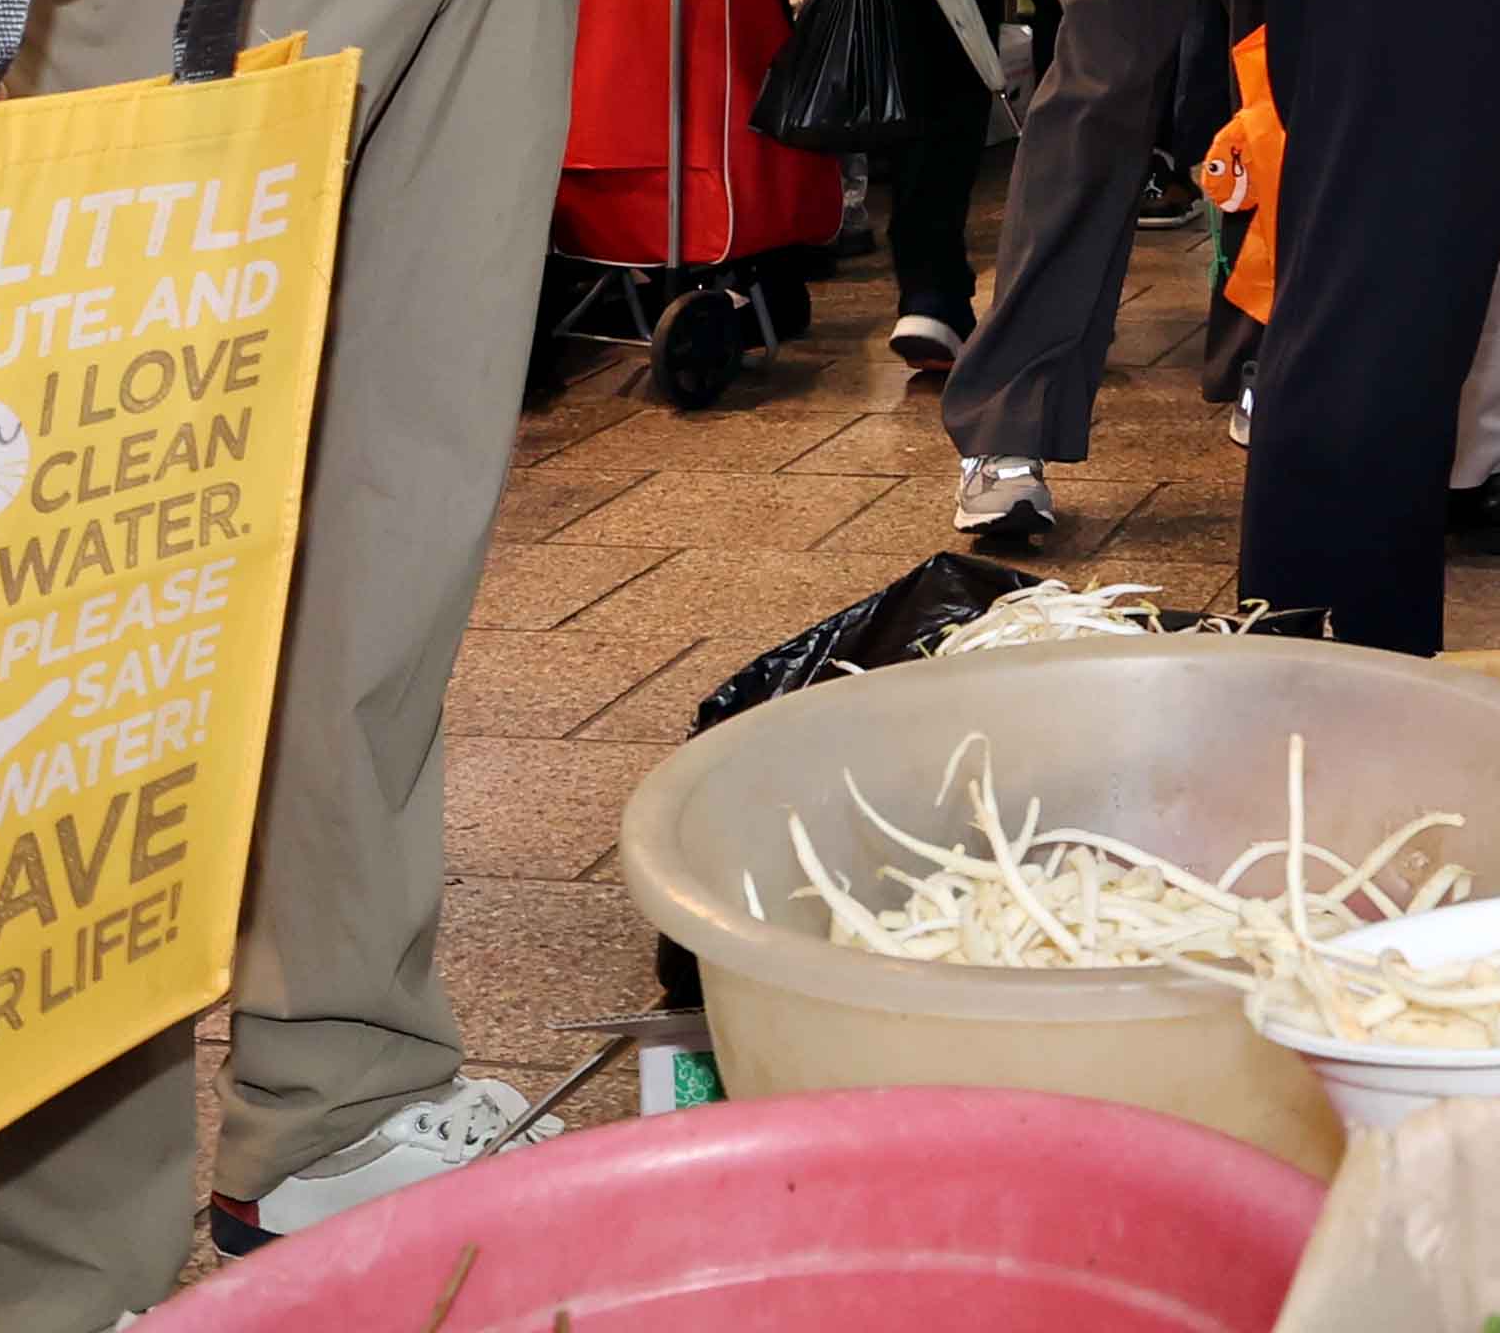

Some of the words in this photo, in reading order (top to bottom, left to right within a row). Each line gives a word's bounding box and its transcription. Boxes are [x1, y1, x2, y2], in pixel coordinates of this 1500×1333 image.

[133, 259, 279, 339] AND
[38, 371, 60, 437] I
[78, 330, 269, 429] LOVE
[30, 407, 253, 513] CLEAN
[69, 624, 222, 720] SAVE
[38, 882, 184, 1015] LIFE!
